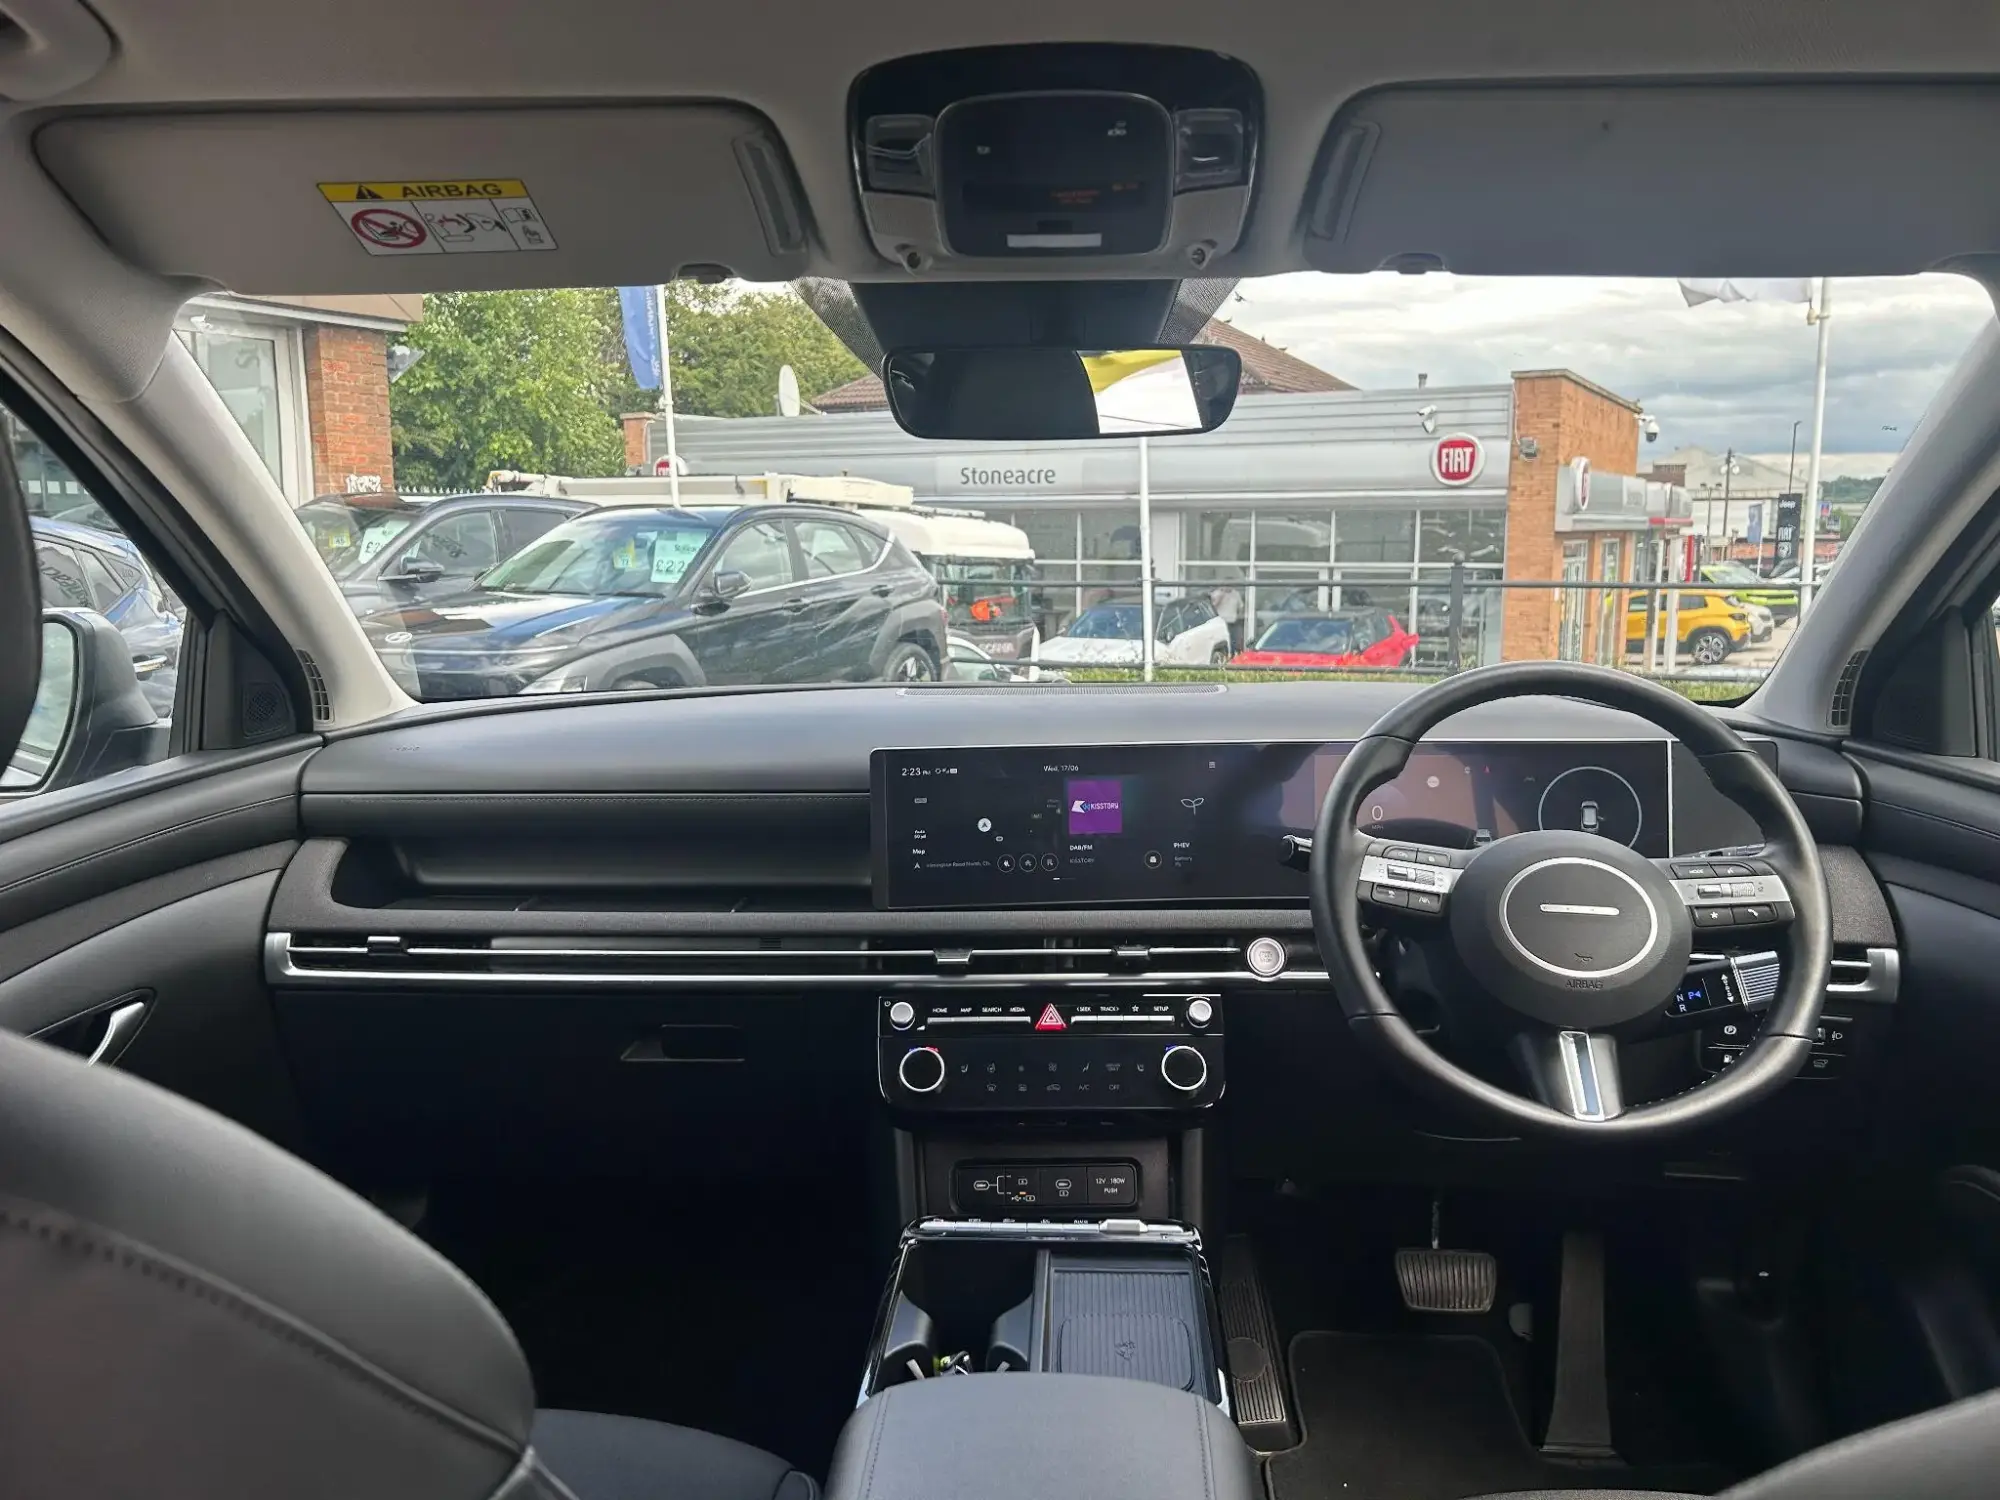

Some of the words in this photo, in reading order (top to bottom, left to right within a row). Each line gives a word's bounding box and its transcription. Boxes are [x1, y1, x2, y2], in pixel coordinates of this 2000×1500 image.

[402, 183, 502, 198] AIRBAG
[1441, 447, 1473, 473] FIAT
[960, 467, 1056, 485] Stoneacre
[1779, 500, 1797, 510] Jeep
[978, 642, 1015, 654] SCANIA
[901, 767, 921, 777] 2:23
[1090, 802, 1119, 810] KISSTORY
[1371, 805, 1384, 821] 0
[912, 848, 926, 856] Map
[1565, 978, 1604, 990] AIRBAG
[1676, 994, 1685, 1002] N
[1687, 991, 1695, 1000] P
[981, 1006, 1002, 1014] SEARCH
[1679, 1004, 1688, 1013] R
[1095, 1177, 1107, 1185] 12V
[1110, 1177, 1126, 1185] 180W
